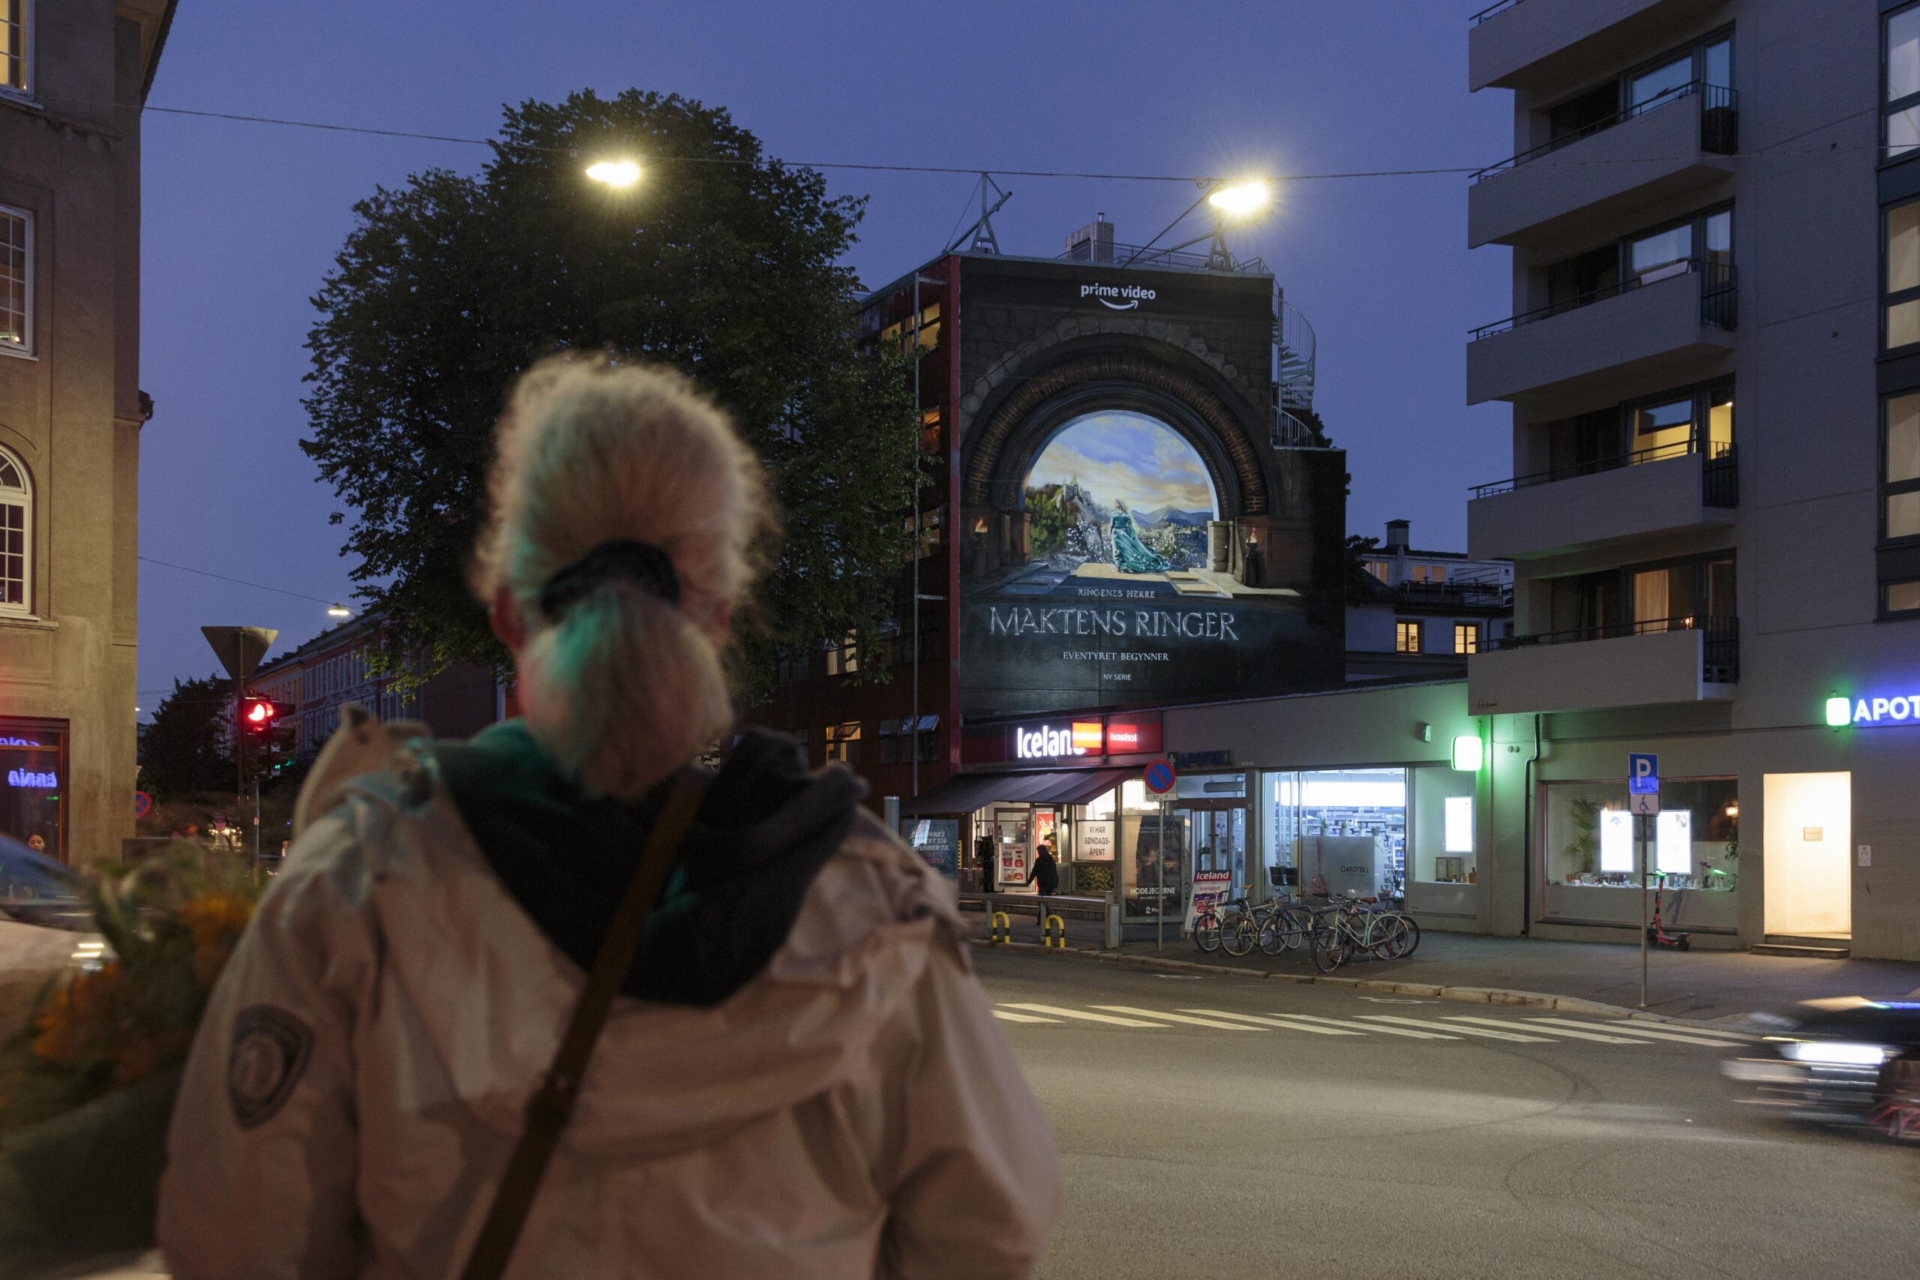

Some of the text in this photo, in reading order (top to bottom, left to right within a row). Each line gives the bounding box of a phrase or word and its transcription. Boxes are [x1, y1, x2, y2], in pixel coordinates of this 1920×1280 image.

[1081, 283, 1156, 300] prime video
[1077, 588, 1156, 599] RINGENES HERRE
[989, 606, 1239, 641] MAKTENS RINGER
[1063, 651, 1170, 662] EVENTYRET BEGYNNER
[1103, 673, 1132, 681] NY SERIE
[1636, 758, 1651, 788] P
[1089, 825, 1106, 834] VI HAR
[1084, 837, 1111, 846] SØNDAGS-
[1089, 847, 1106, 856] ÅPENT
[1196, 871, 1230, 880] Iceland
